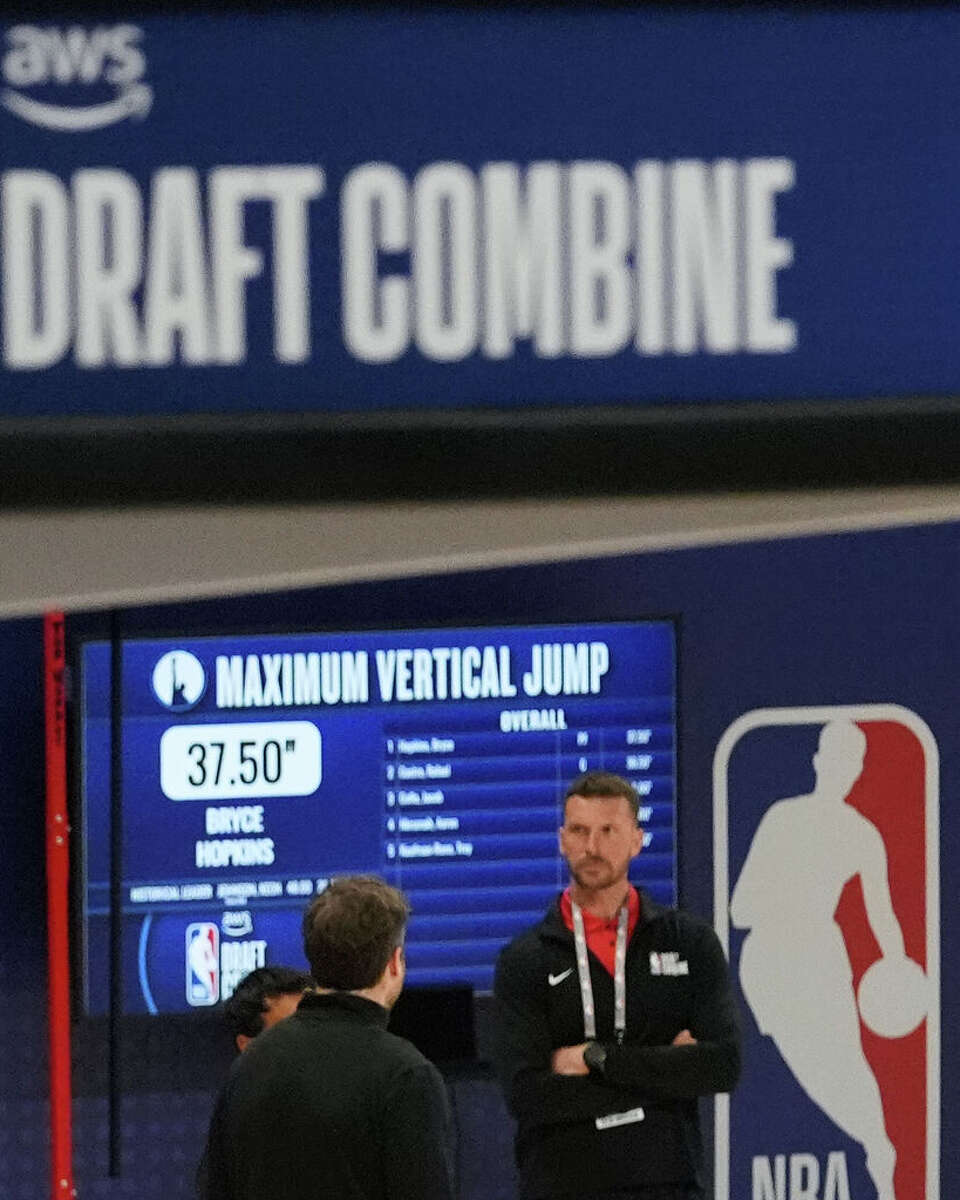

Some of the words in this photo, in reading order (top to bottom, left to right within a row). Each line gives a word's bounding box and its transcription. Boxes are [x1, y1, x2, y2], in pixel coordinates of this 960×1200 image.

[2, 25, 149, 88] aws
[1, 166, 324, 370] DRAFT
[341, 158, 797, 363] COMBINE
[215, 651, 369, 708] MAXIMUM
[375, 645, 517, 702] VERTICAL
[523, 642, 609, 697] JUMP
[500, 708, 568, 733] OVERALL
[188, 739, 296, 787] 37.50"
[205, 805, 265, 835] BRYCE
[195, 837, 275, 868] HOPKINS
